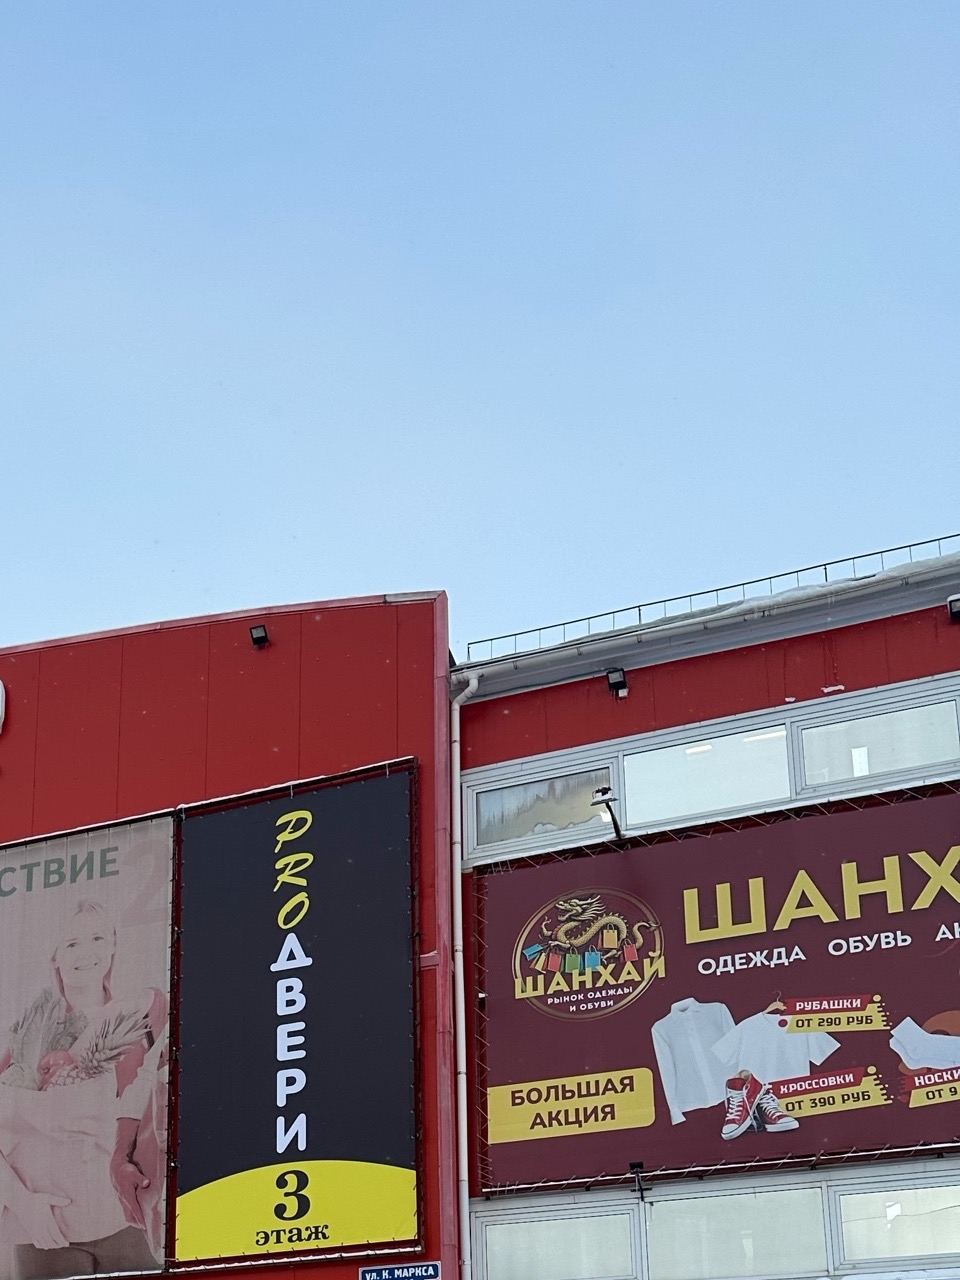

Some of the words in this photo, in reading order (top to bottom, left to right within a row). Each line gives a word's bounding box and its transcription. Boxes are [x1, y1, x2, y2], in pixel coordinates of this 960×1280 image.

[698, 946, 806, 975] ОДЕЖДА
[828, 930, 912, 956] ОБУВЬ
[515, 950, 666, 999] ШАНХАЙ
[547, 993, 584, 1005] РЫНОК
[587, 986, 633, 999] ОДЕЖДЫ
[580, 1000, 614, 1011] ОБУВИ
[796, 999, 861, 1011] РУБАШКИ
[796, 1019, 813, 1028] ОТ
[818, 1017, 841, 1027] 290
[847, 1015, 873, 1026] РУБ
[780, 1074, 854, 1094] КРОССОВКИ
[914, 1070, 960, 1087] НОСКИ
[511, 1076, 635, 1107] БОЛЬШАЯ
[785, 1101, 804, 1112] ОТ
[810, 1096, 836, 1109] 390
[841, 1091, 871, 1104] РУБ
[926, 1089, 944, 1100] ОТ
[529, 1104, 616, 1131] АКЦИЯ
[274, 1170, 311, 1221] 3
[256, 1224, 330, 1246] этаж
[382, 1270, 392, 1279] К.
[394, 1266, 435, 1278] МАРКСА
